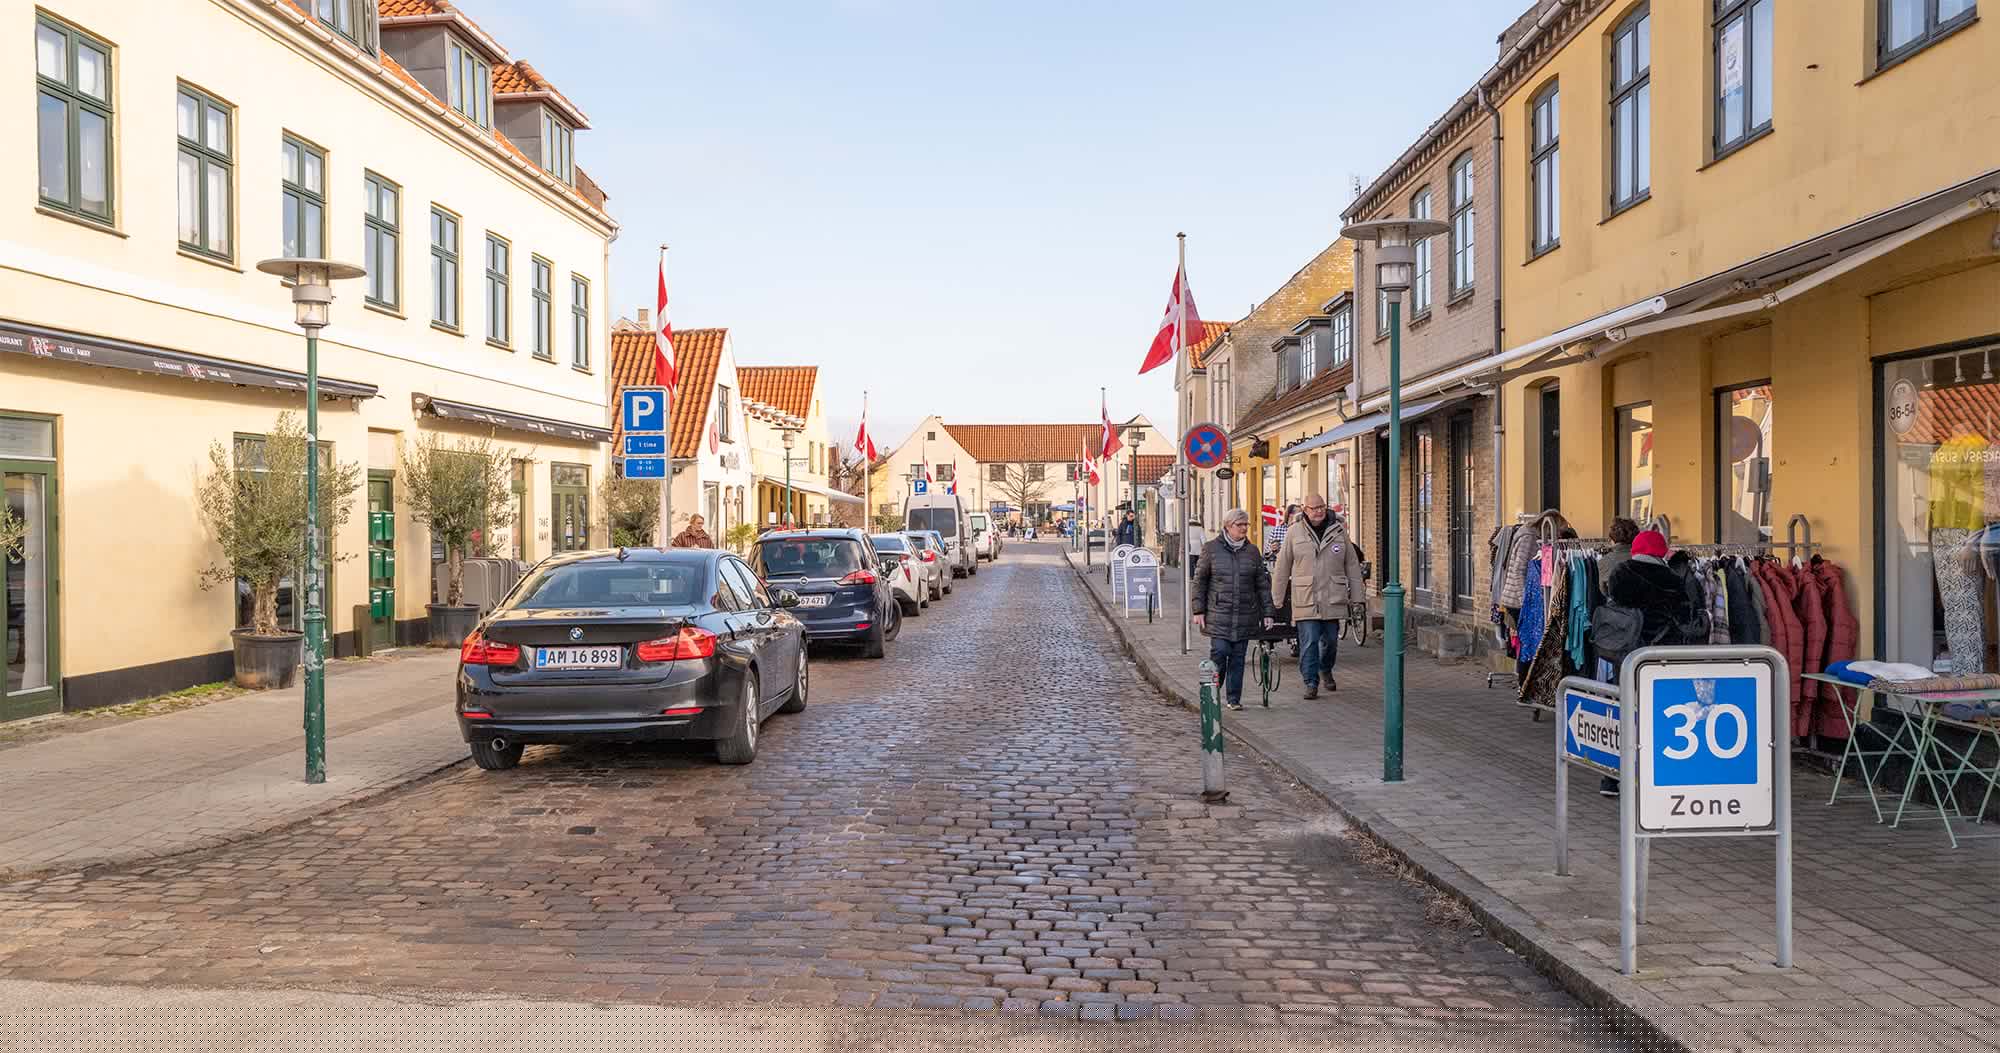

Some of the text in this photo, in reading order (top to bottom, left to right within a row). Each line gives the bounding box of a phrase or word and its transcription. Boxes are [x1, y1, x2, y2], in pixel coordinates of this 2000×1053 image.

[632, 395, 655, 427] P
[1889, 402, 1916, 420] 36-54
[917, 482, 924, 491] P
[547, 649, 618, 664] AM 16 898
[1662, 701, 1748, 760] 30
[1670, 794, 1742, 816] Zone
